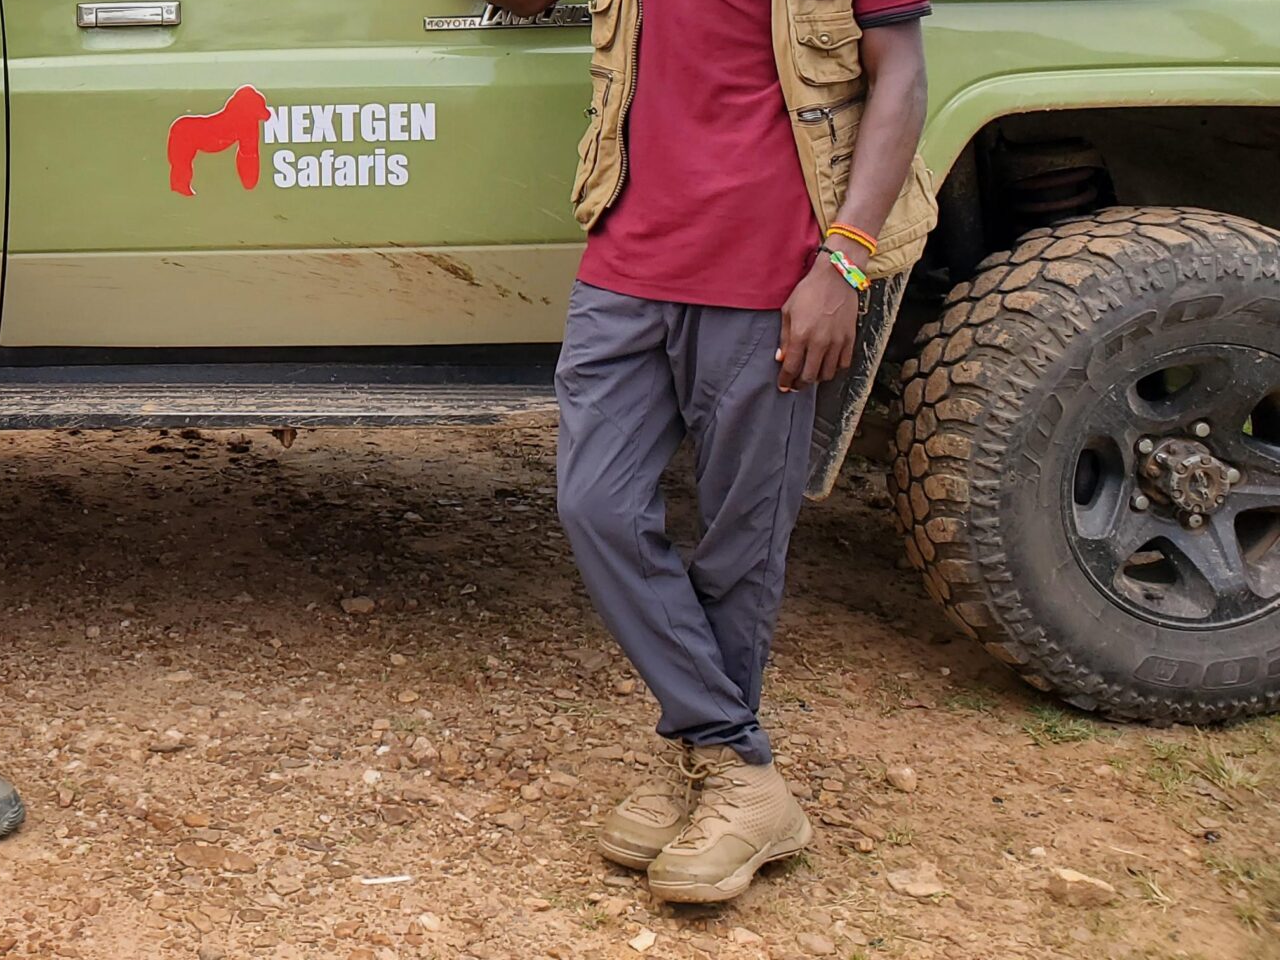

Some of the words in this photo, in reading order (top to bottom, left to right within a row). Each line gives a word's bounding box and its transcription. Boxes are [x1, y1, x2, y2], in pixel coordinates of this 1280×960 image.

[428, 19, 476, 29] TOYOTA
[264, 103, 437, 145] NEXTGEN
[273, 148, 410, 189] Safaris
